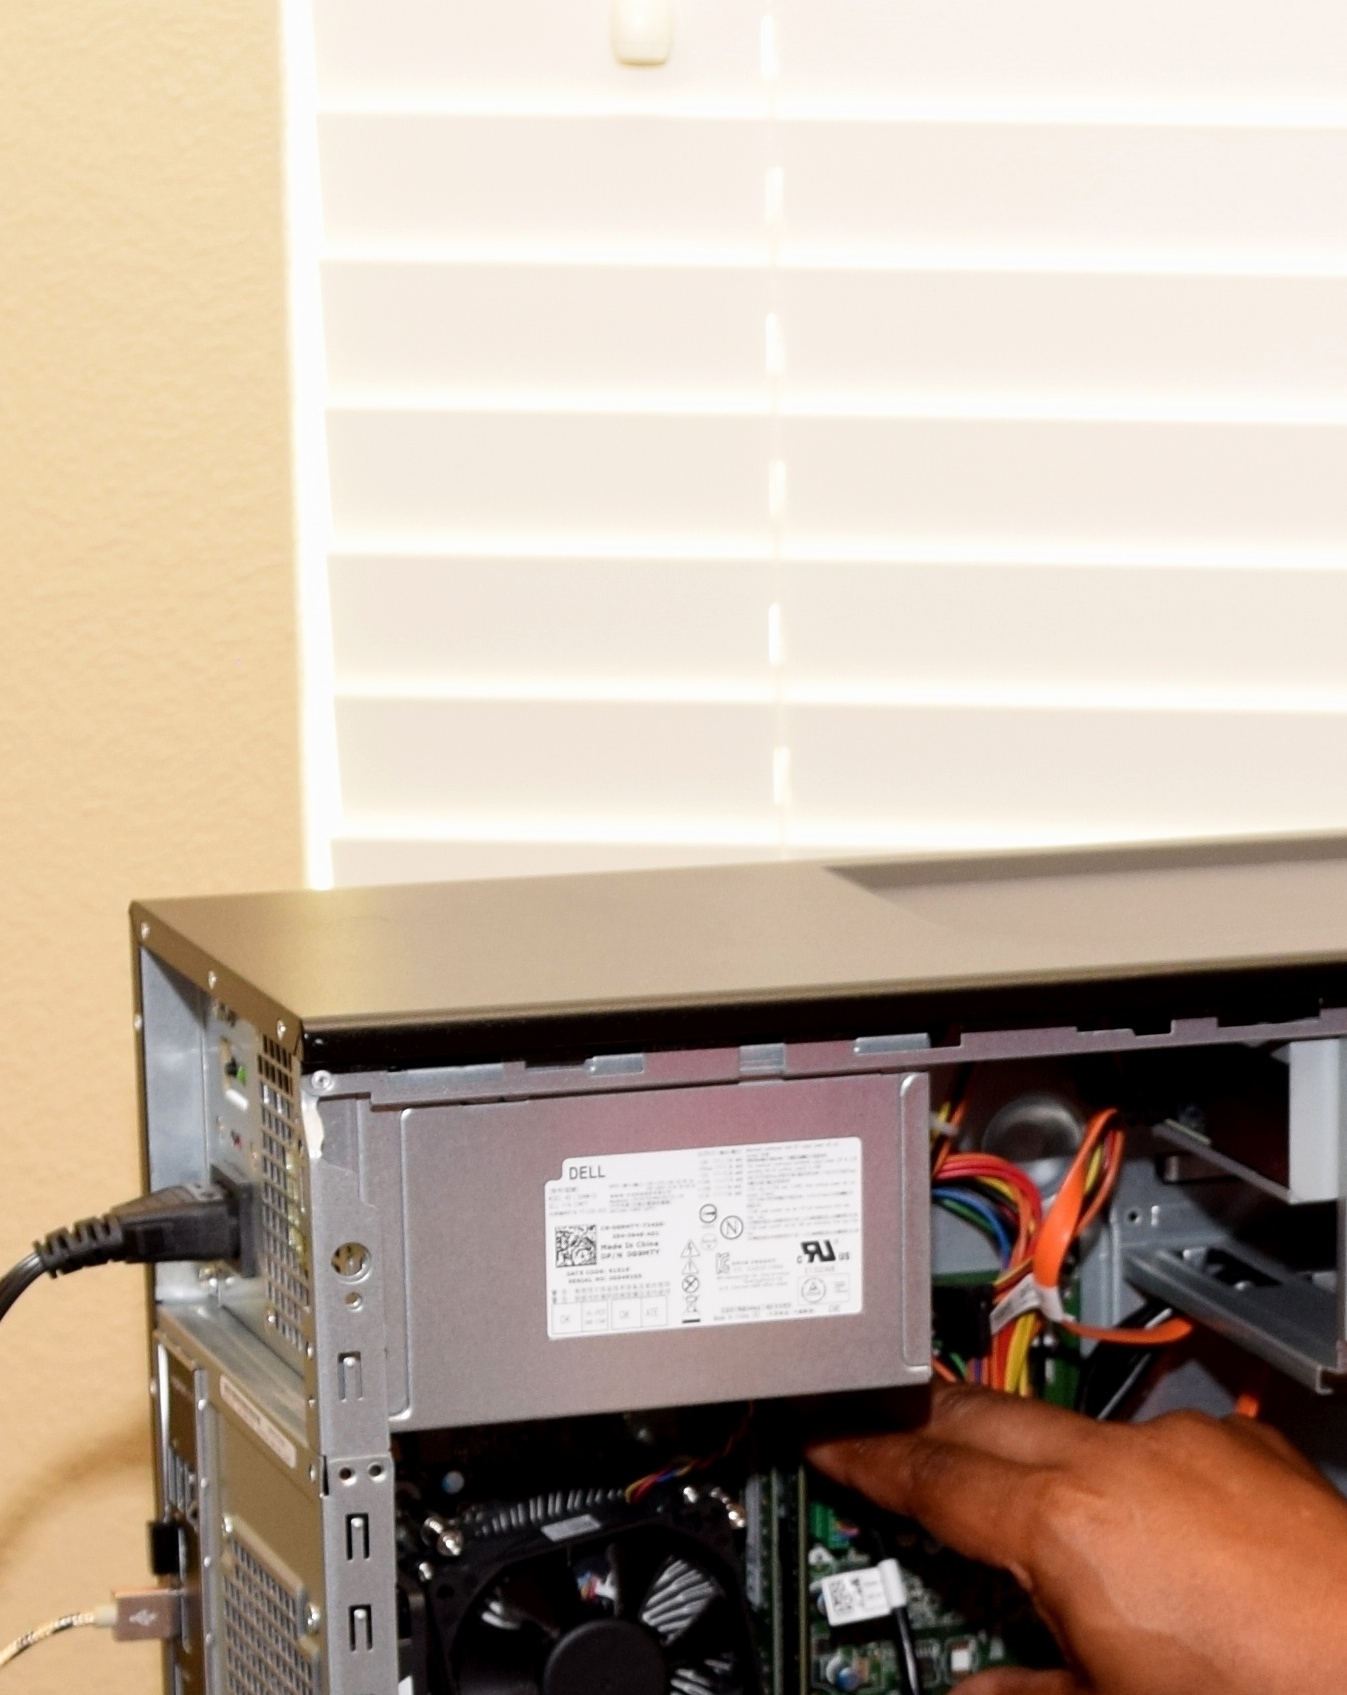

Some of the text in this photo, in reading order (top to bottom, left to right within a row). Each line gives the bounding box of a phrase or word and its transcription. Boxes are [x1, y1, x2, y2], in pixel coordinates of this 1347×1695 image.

[569, 1165, 605, 1180] DELL
[601, 1243, 622, 1251] Made
[637, 1240, 659, 1249] China
